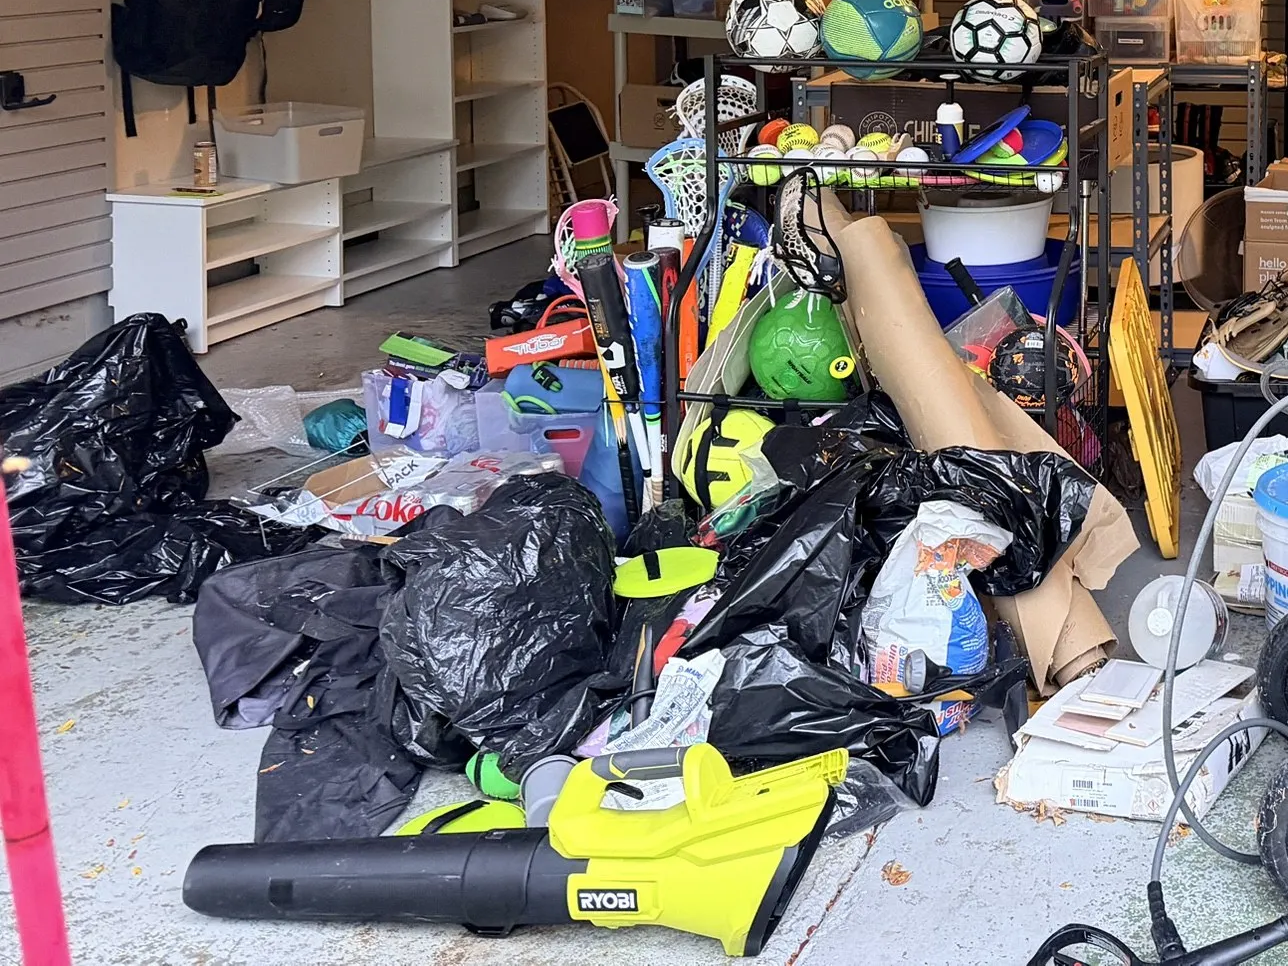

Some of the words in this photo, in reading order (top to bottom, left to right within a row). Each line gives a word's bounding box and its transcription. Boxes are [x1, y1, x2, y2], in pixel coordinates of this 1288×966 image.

[862, 114, 896, 128] CHIPOTLE
[904, 120, 981, 143] CHIPE
[1259, 256, 1287, 269] hello
[386, 459, 419, 487] PACK
[356, 493, 425, 523] Coke
[579, 892, 636, 909] RYOBI
